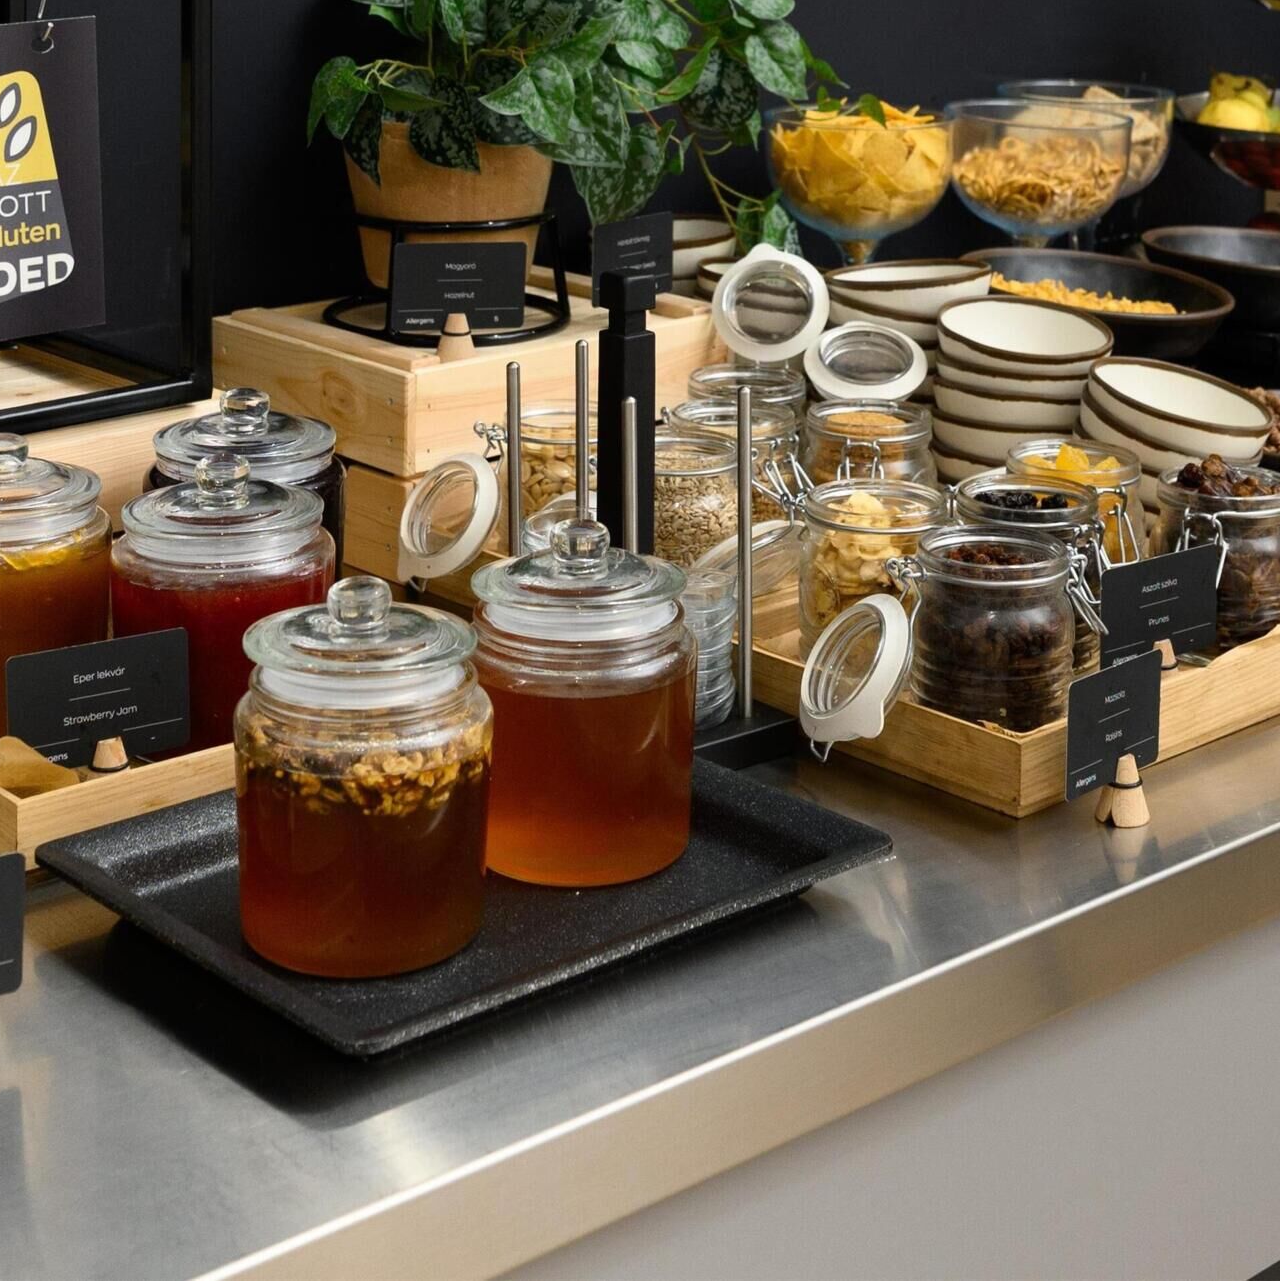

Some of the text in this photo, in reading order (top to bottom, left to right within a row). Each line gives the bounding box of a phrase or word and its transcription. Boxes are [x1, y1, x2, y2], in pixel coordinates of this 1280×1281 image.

[405, 317, 435, 325] Allergens
[73, 666, 126, 685] Eper lekvár
[64, 705, 138, 727] Strawberry Jam
[1075, 773, 1097, 788] Allergens
